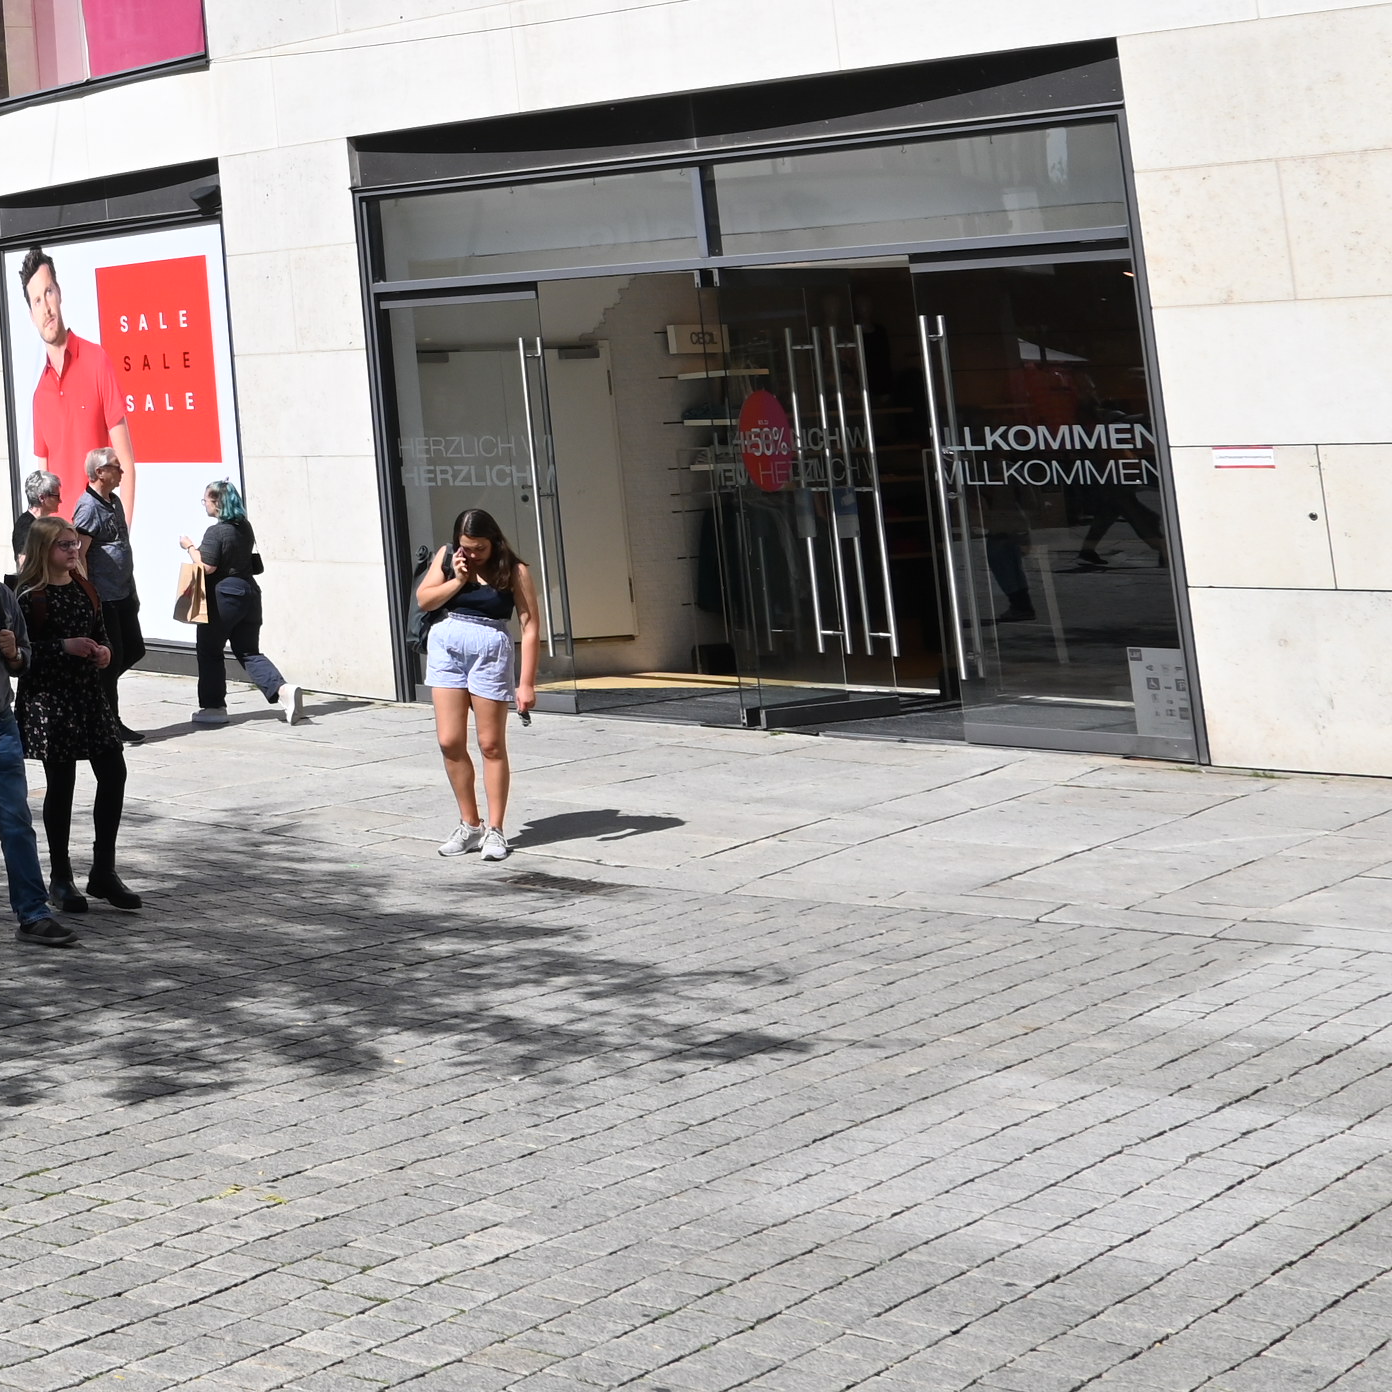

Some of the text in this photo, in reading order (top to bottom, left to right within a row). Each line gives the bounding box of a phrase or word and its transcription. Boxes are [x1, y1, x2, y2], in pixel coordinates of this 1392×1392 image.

[119, 309, 189, 333] SALE
[123, 351, 191, 372] SALE
[125, 392, 195, 413] SALE
[398, 435, 516, 458] HERZLICH
